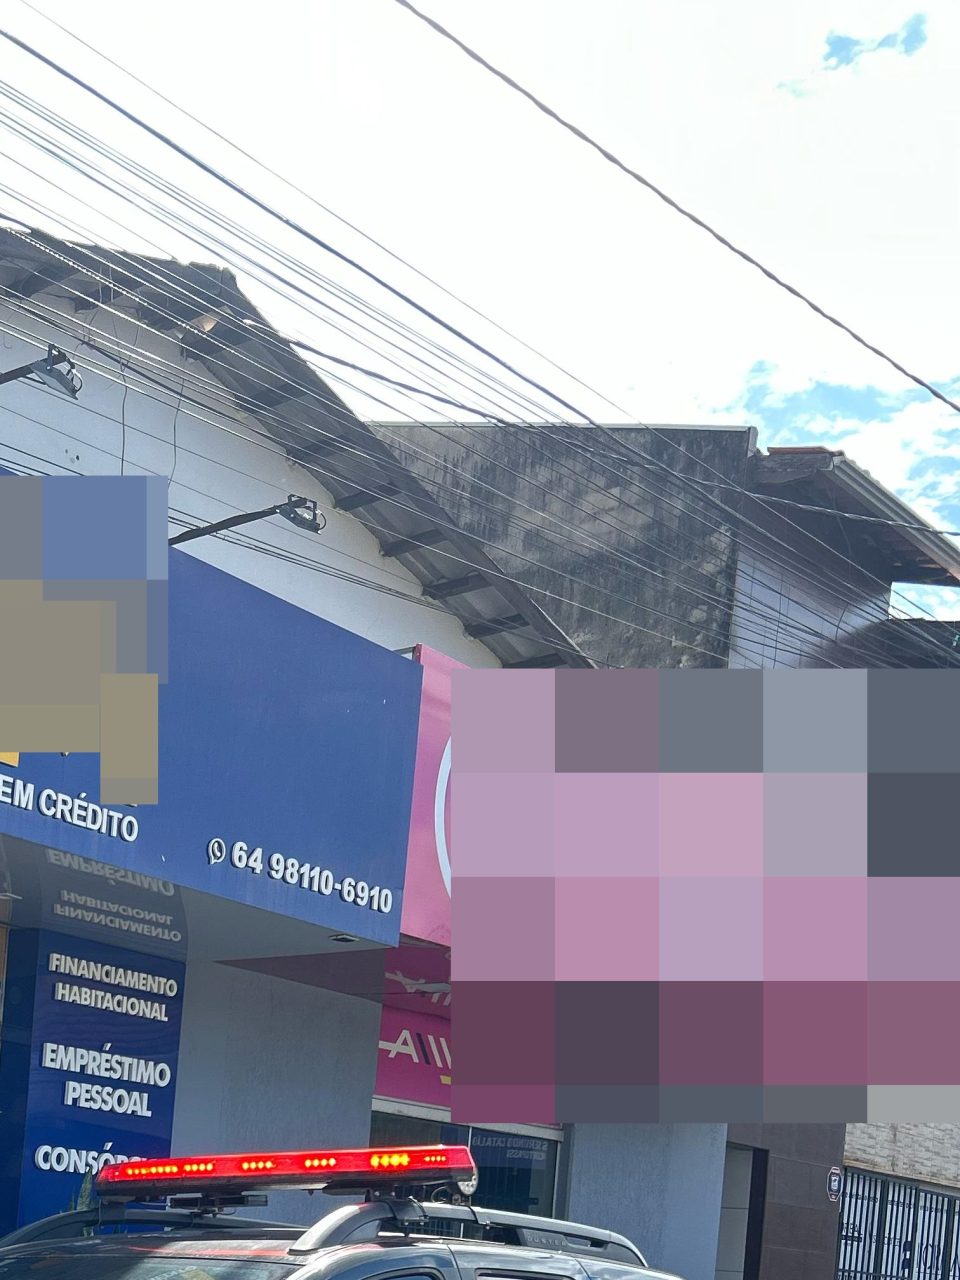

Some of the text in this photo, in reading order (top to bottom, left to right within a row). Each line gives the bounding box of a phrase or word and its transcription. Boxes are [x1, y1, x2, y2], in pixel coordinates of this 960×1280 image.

[39, 792, 139, 842] CRÉDITO
[231, 841, 392, 913] 64 98110-6910
[49, 953, 177, 998] FINANCIAMENTO
[55, 982, 168, 1022] HABITACIONAL
[42, 1042, 171, 1088] EMPRÉSTIMO
[64, 1081, 152, 1118] PESSOAL
